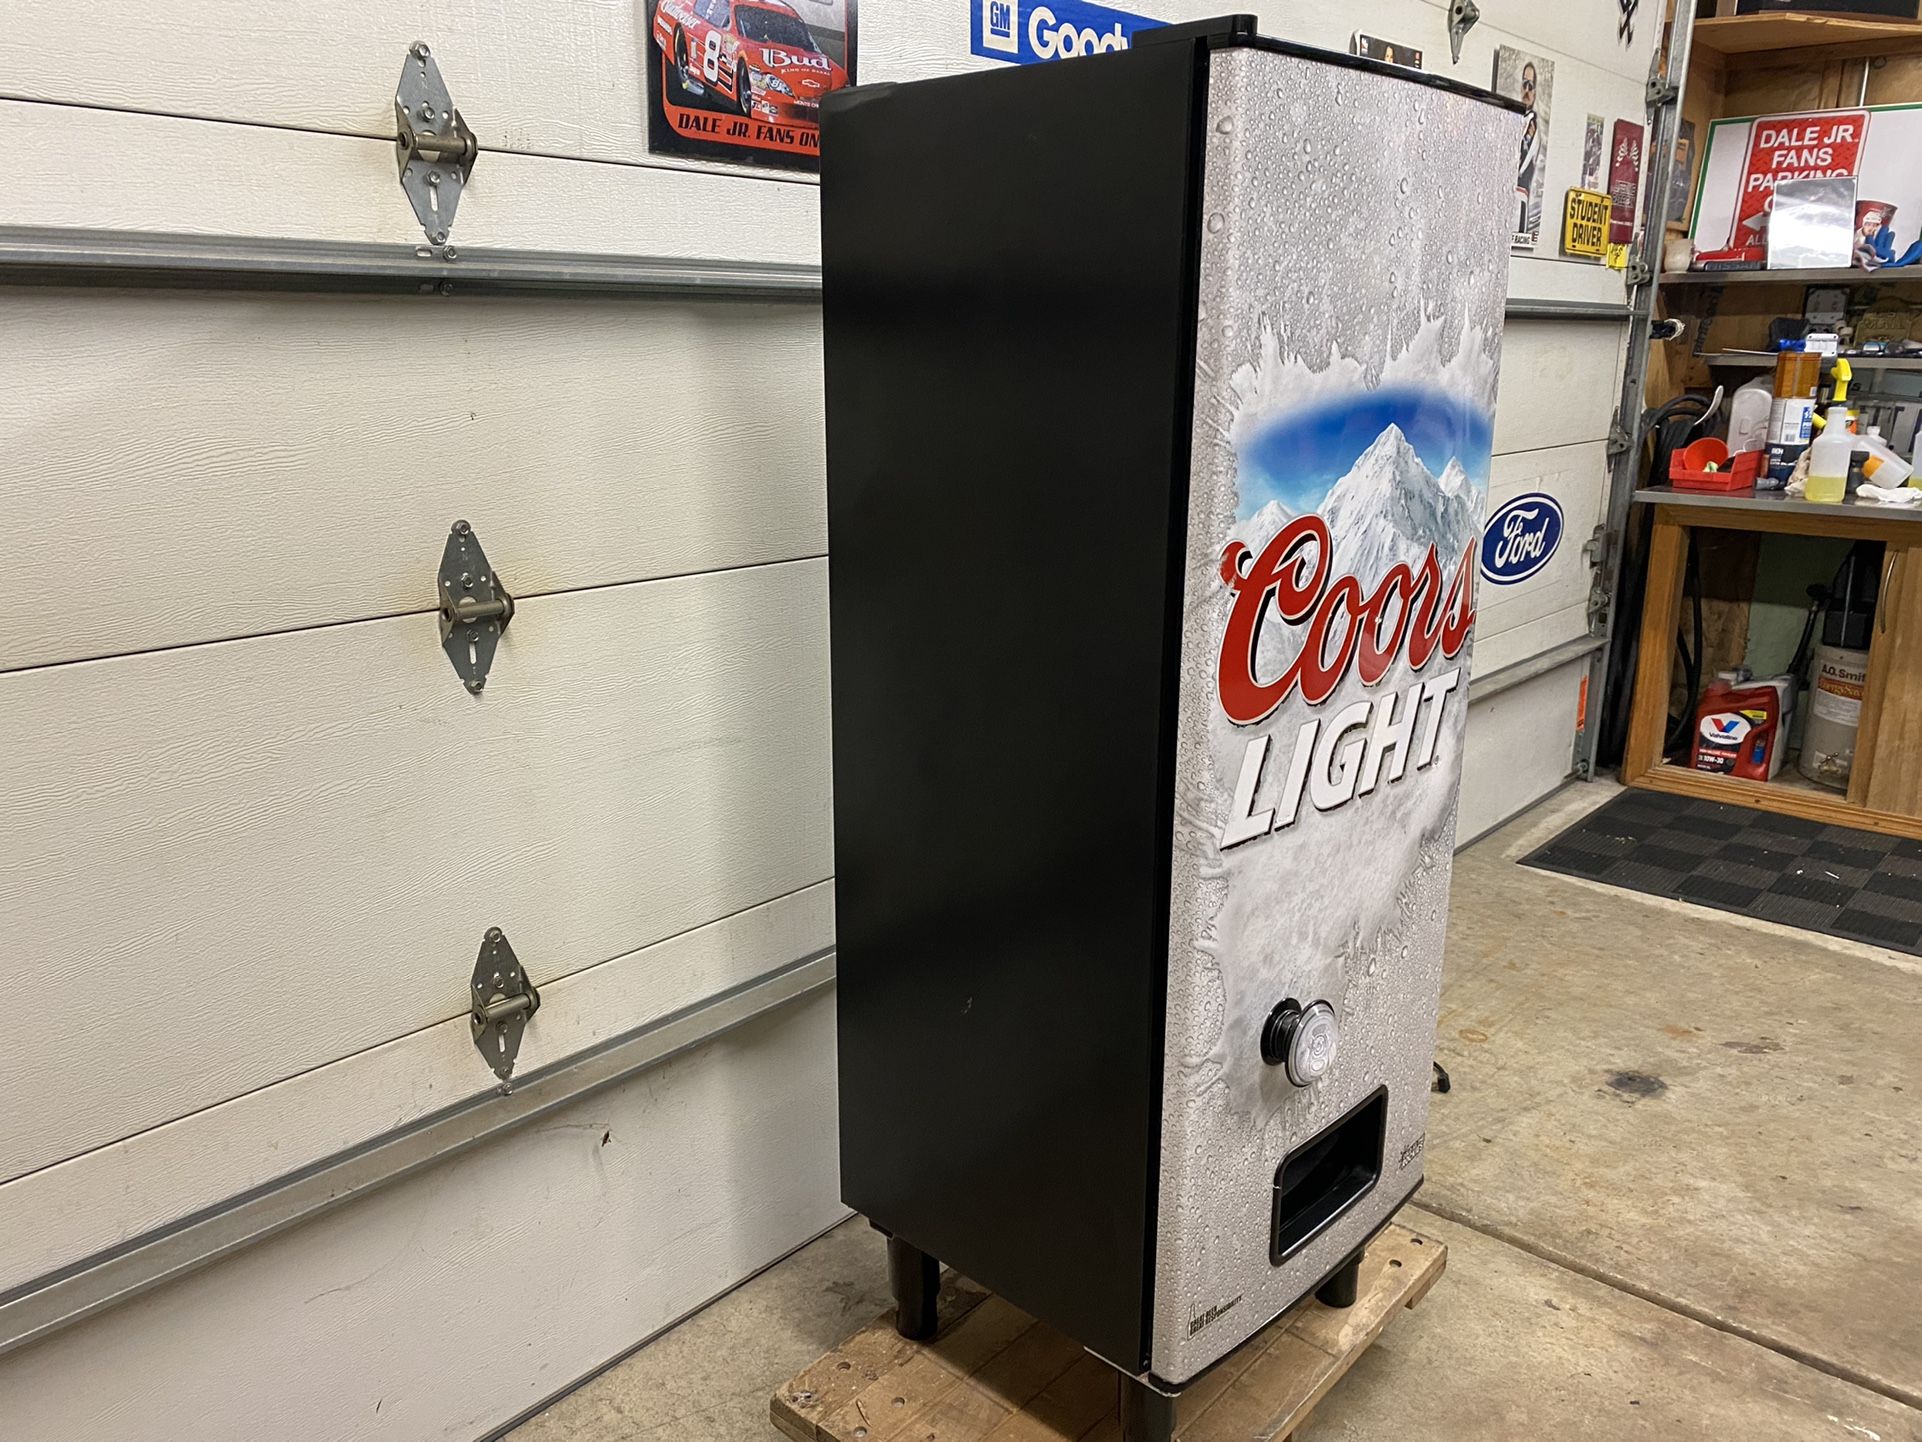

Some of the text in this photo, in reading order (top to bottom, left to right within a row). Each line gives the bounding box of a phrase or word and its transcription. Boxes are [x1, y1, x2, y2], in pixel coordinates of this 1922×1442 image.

[989, 0, 1011, 32] GM
[703, 29, 722, 86] 8
[759, 47, 832, 70] Bud
[678, 113, 723, 134] DALE
[726, 120, 751, 139] JR.
[755, 124, 796, 145] FANS
[1759, 126, 1821, 149] DALE
[1771, 147, 1833, 169] FANS
[1569, 197, 1609, 227] STUDENT
[1571, 222, 1602, 248] DRIVER
[1494, 508, 1550, 569] Ford
[1218, 514, 1477, 727] Coors
[1821, 664, 1838, 677] A.O.
[1709, 731, 1738, 741] Valvoline
[1219, 667, 1461, 852] LIGHT
